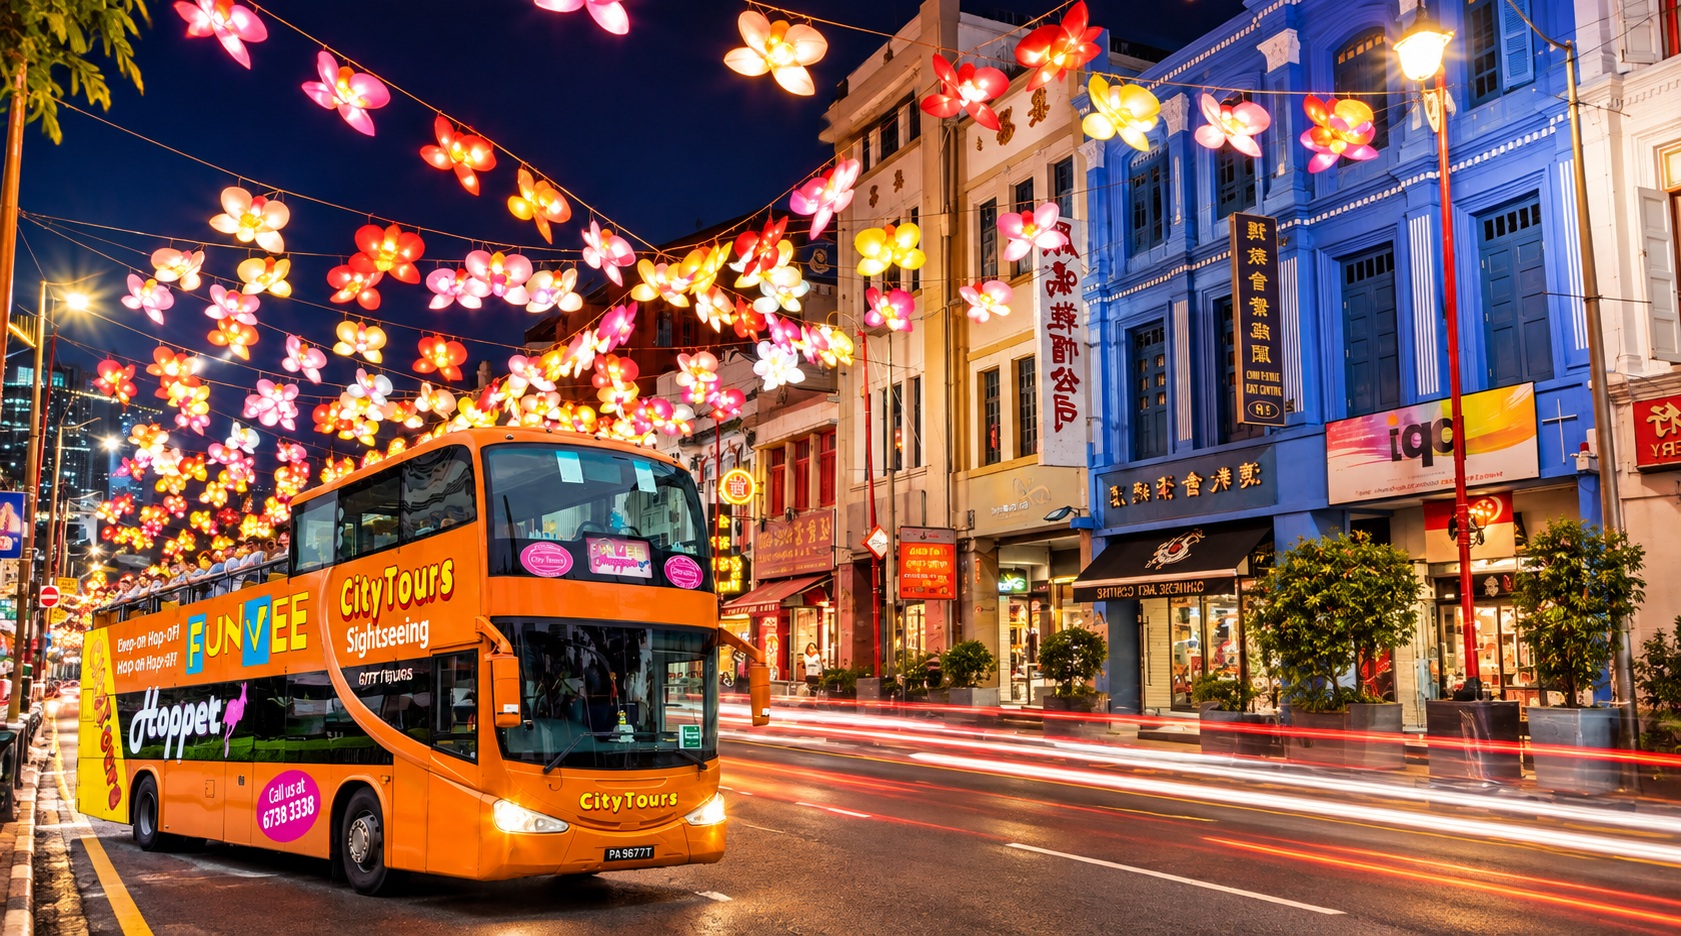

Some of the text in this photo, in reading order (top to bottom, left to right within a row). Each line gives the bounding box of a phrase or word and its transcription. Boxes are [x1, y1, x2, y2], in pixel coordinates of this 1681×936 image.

[346, 616, 430, 658] Sightseeing
[268, 777, 306, 804] Call us at
[263, 795, 315, 830] 6738 3338
